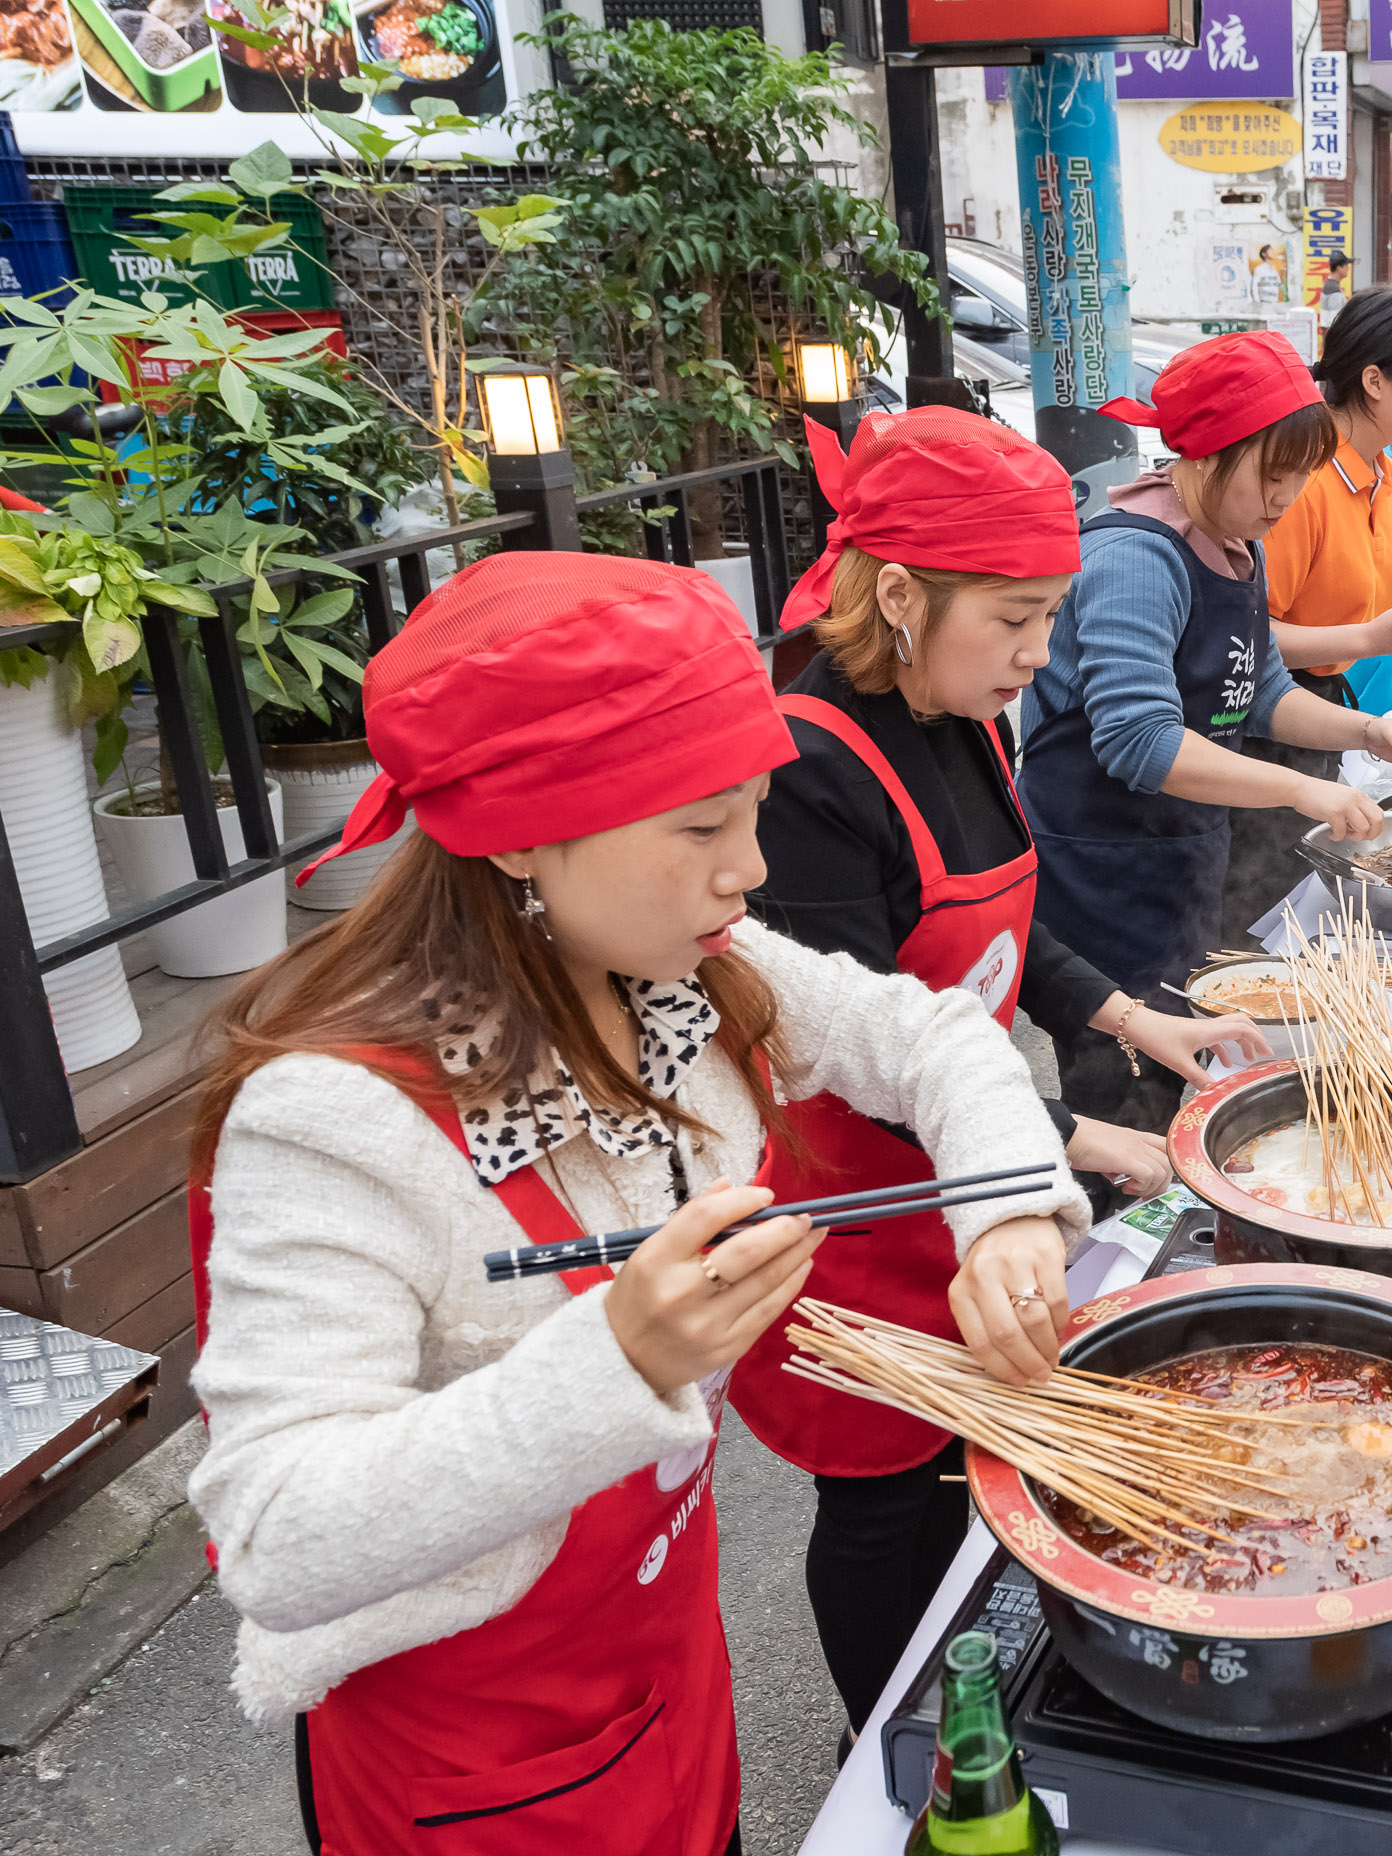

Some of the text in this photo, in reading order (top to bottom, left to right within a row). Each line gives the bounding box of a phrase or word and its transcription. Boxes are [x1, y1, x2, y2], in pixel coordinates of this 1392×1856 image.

[1308, 160, 1342, 177] 재단
[110, 253, 176, 282] TERRA
[249, 256, 300, 282] TERRA
[1035, 152, 1075, 407] 나라사랑 가족사랑
[1067, 157, 1107, 403] 무지개국토사랑단
[1228, 635, 1255, 676] 처음
[1221, 679, 1256, 710] 처럼
